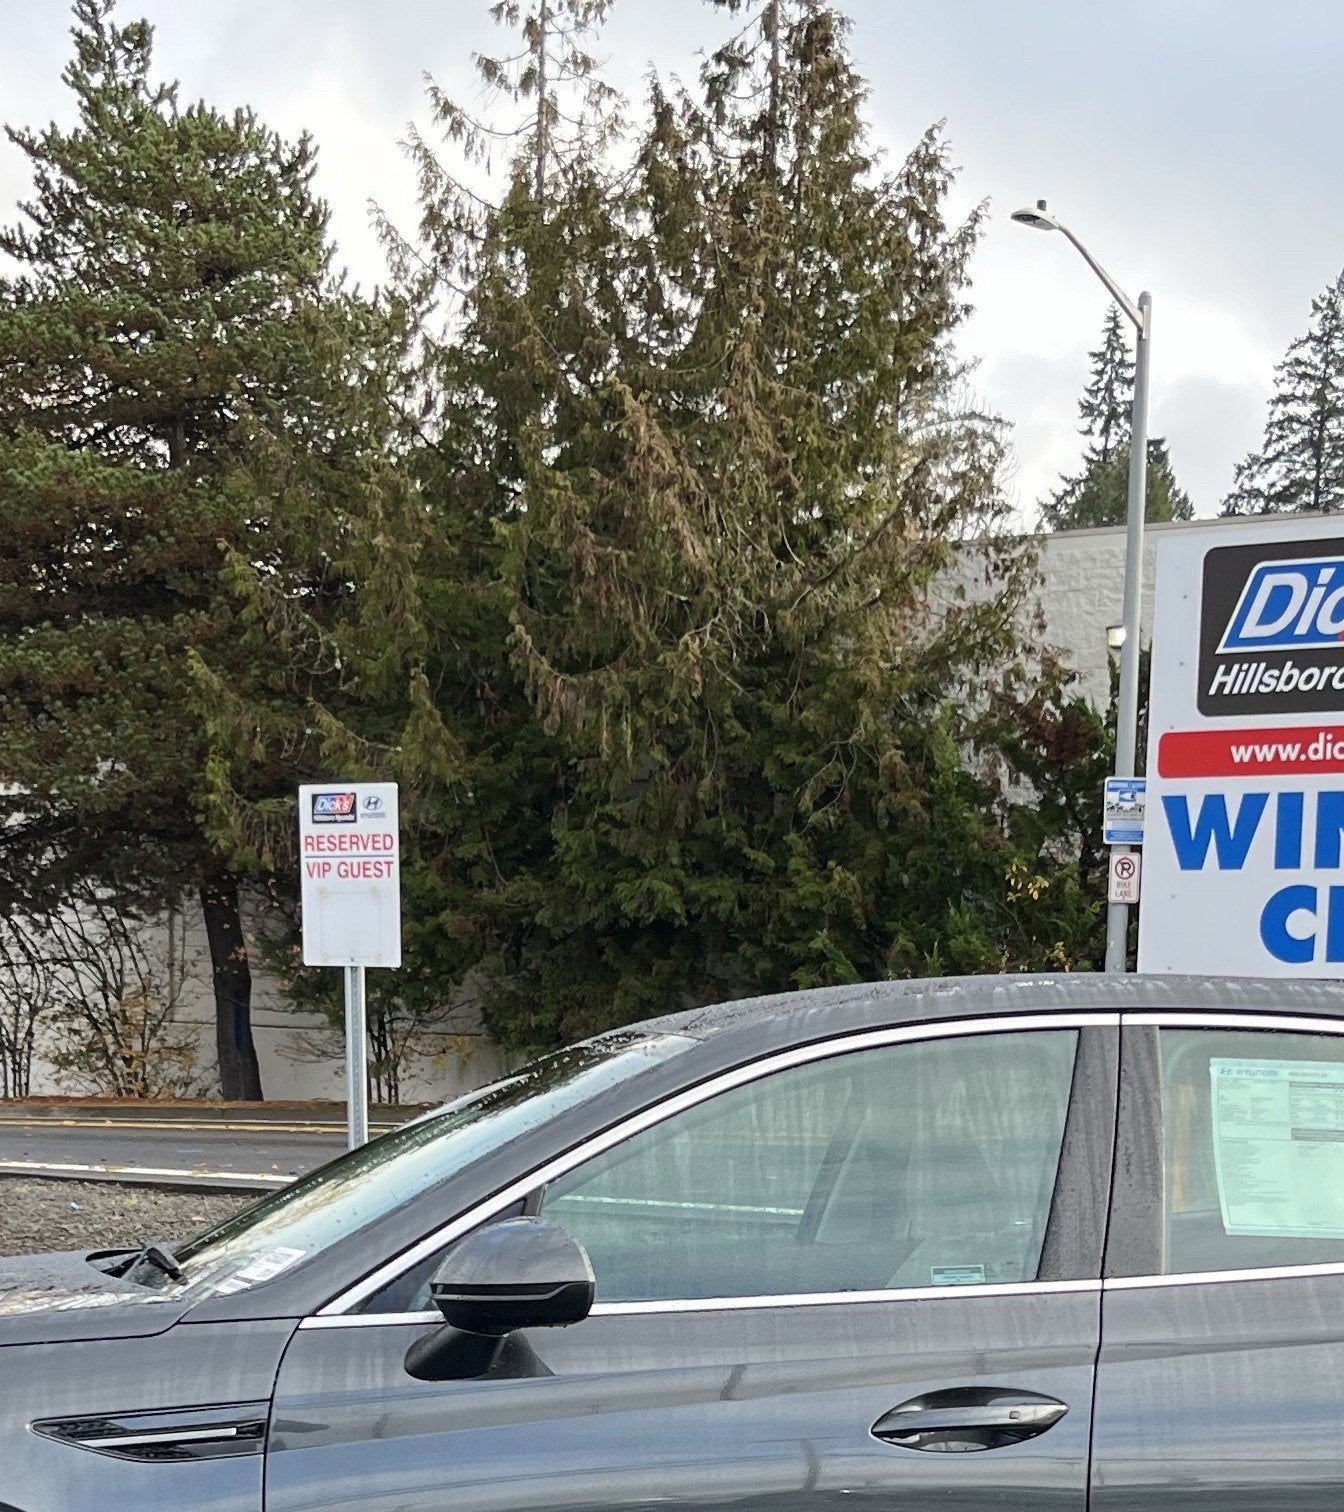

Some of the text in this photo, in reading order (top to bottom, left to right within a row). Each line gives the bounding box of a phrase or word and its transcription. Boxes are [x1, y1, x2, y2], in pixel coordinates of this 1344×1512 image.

[305, 833, 394, 852] RESERVED
[306, 860, 395, 879] VIP GUEST
